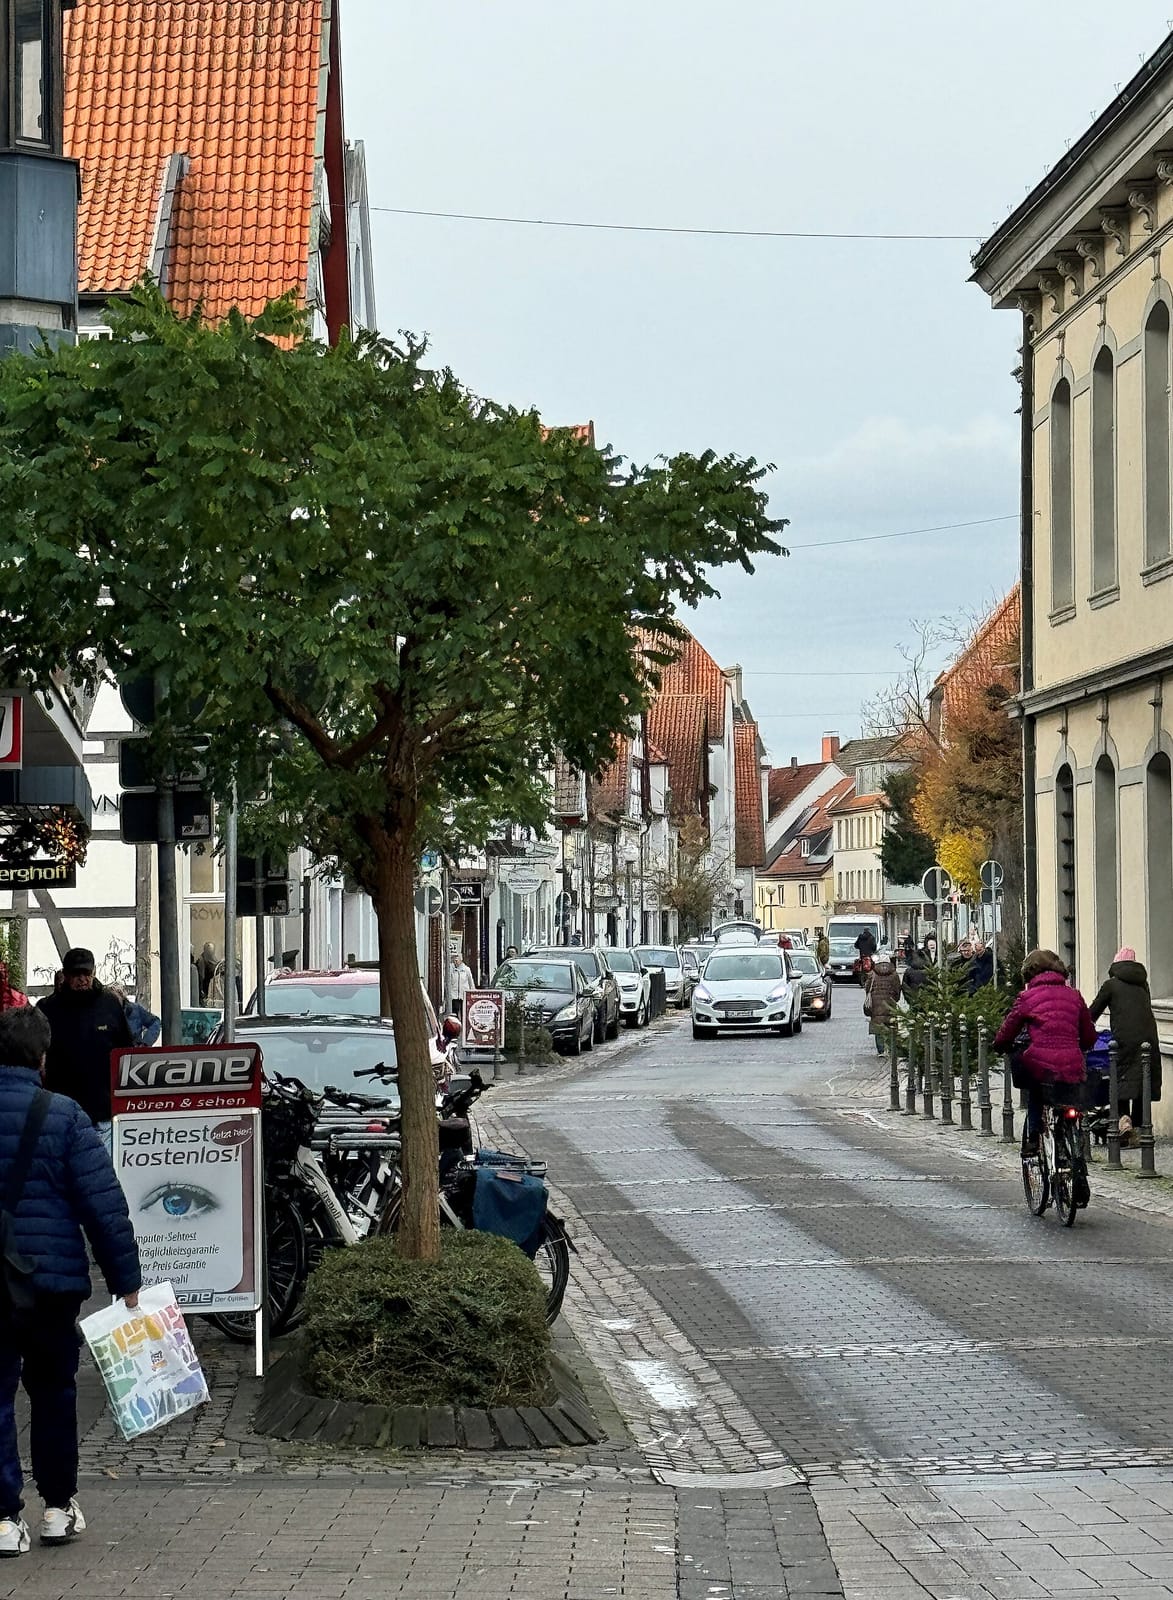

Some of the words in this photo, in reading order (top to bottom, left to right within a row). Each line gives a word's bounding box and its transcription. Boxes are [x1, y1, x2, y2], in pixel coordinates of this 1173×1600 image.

[120, 1054, 251, 1087] krane
[126, 1099, 175, 1111] hören
[179, 1097, 193, 1108] &
[196, 1095, 246, 1107] sehen
[121, 1124, 211, 1146] Sehtest
[122, 1144, 241, 1168] kostenlos!
[135, 1231, 197, 1245] mputer-Sehtest
[139, 1244, 220, 1259] träglichkeitsgarantie
[172, 1259, 207, 1270] Garantie
